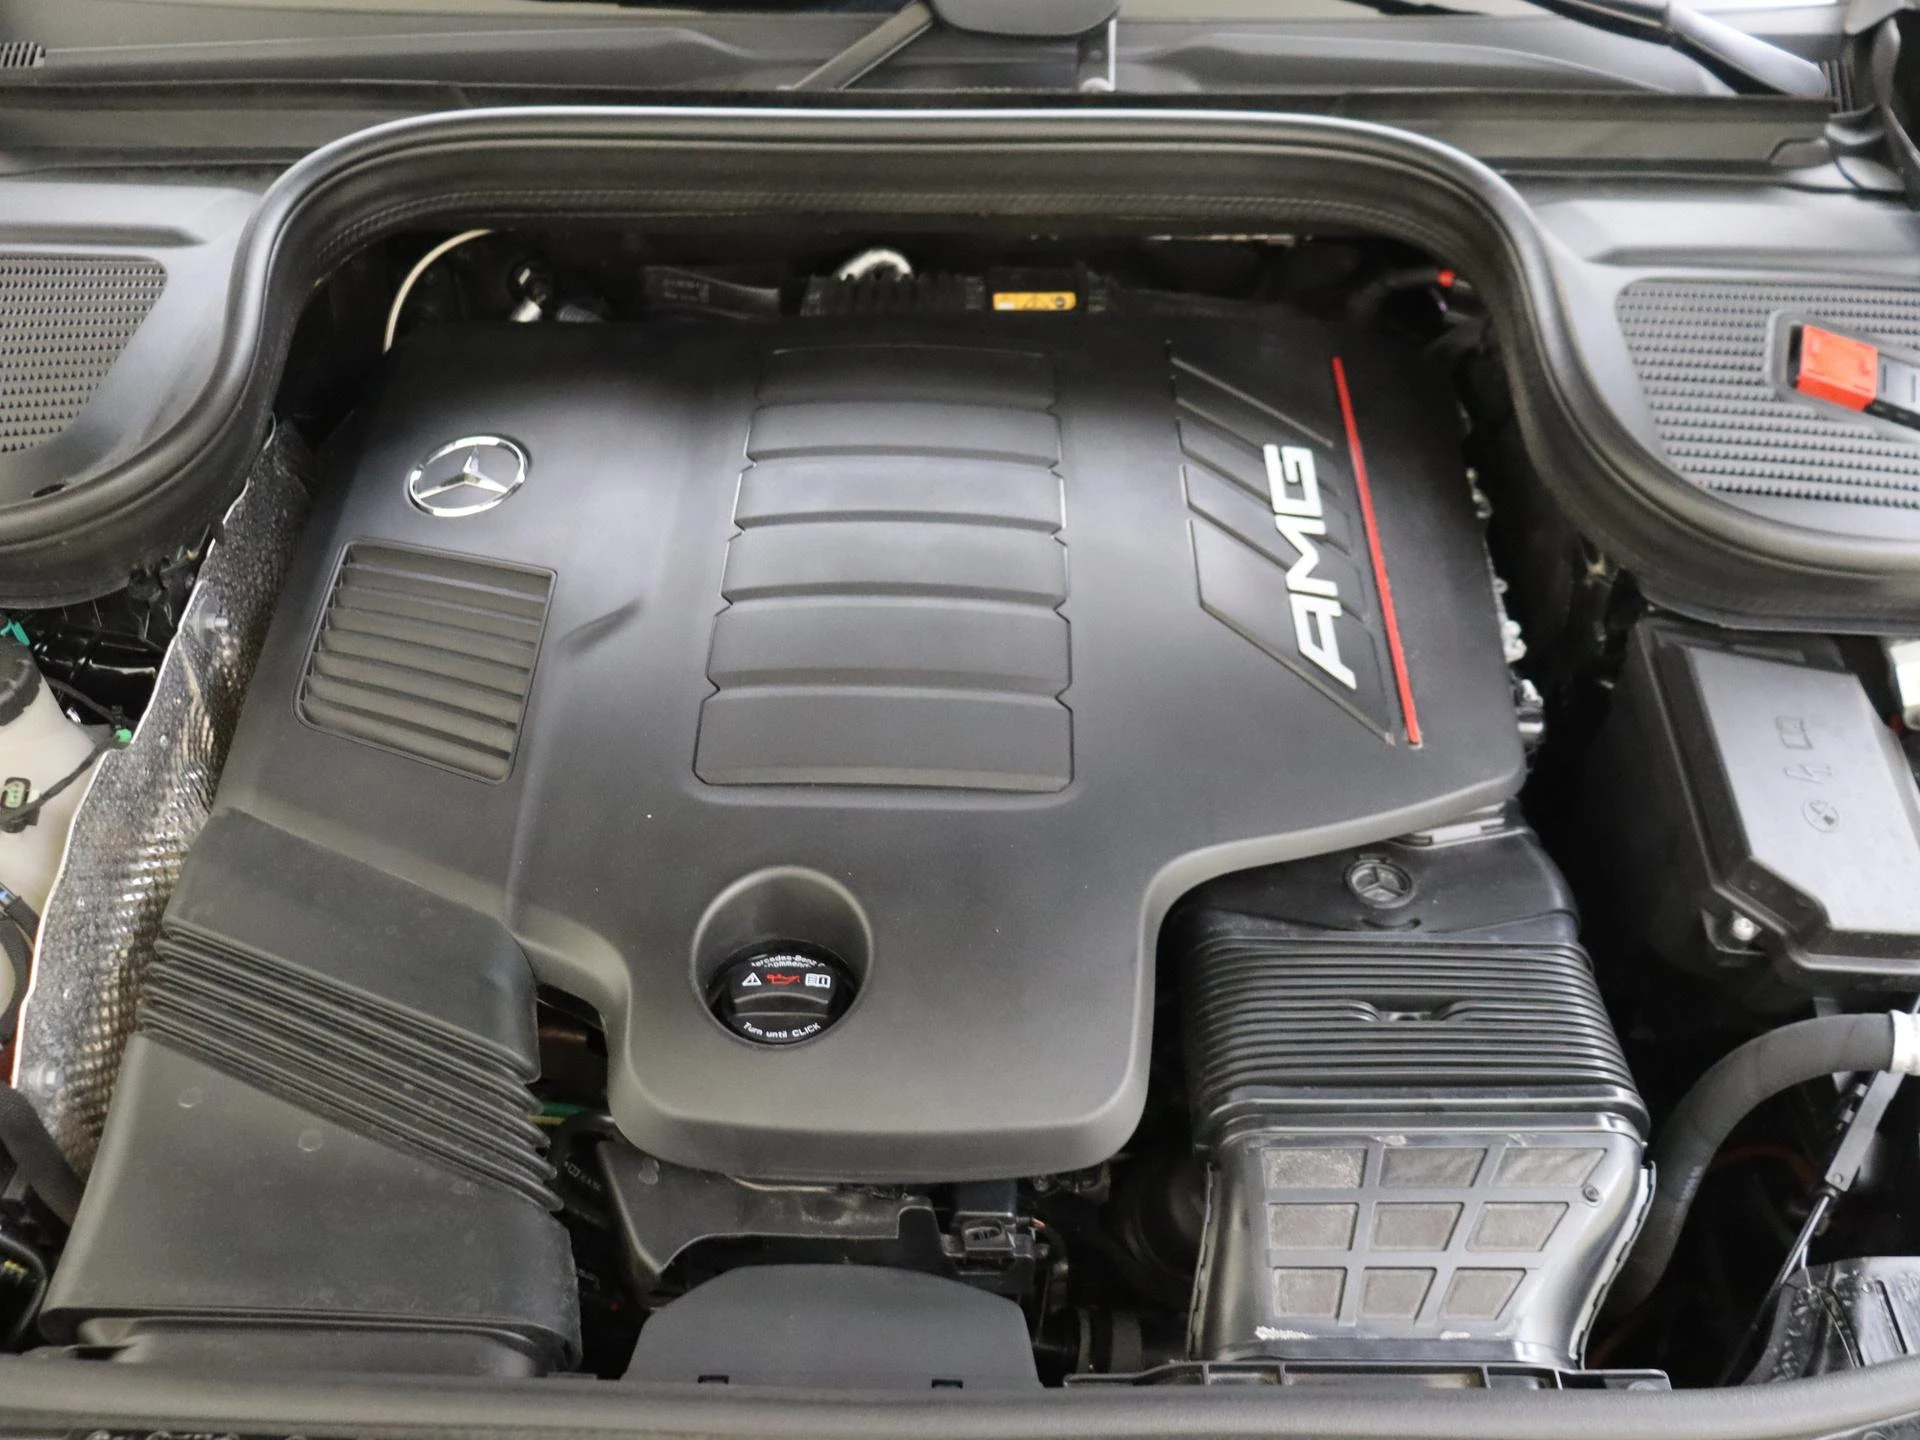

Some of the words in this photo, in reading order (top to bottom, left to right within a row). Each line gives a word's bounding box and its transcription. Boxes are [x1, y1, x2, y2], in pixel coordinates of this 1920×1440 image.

[1263, 443, 1357, 690] AMG
[743, 1022, 763, 1035] Turn
[766, 1030, 787, 1038] until
[792, 1023, 821, 1037] CLICK
